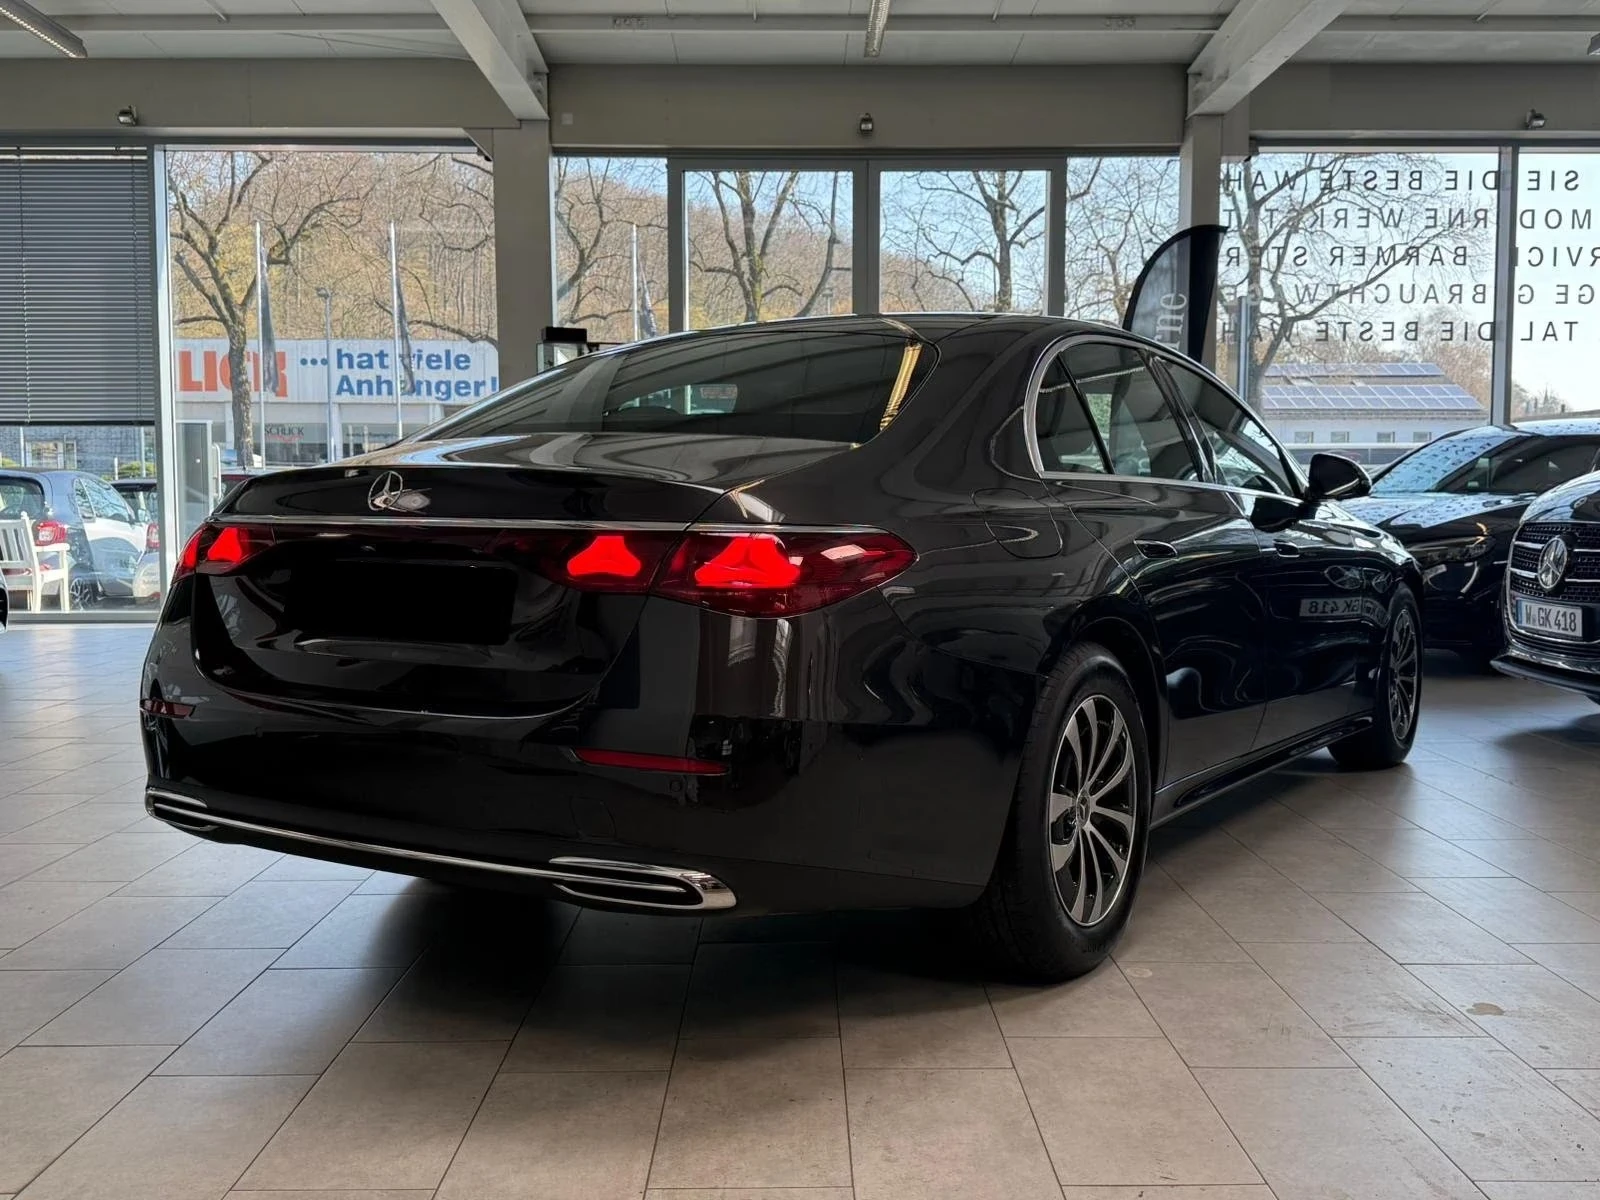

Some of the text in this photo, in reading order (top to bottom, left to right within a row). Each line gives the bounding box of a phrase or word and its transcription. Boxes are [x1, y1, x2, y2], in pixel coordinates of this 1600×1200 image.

[336, 348, 389, 370] hat
[1525, 603, 1577, 633] W GK 418
